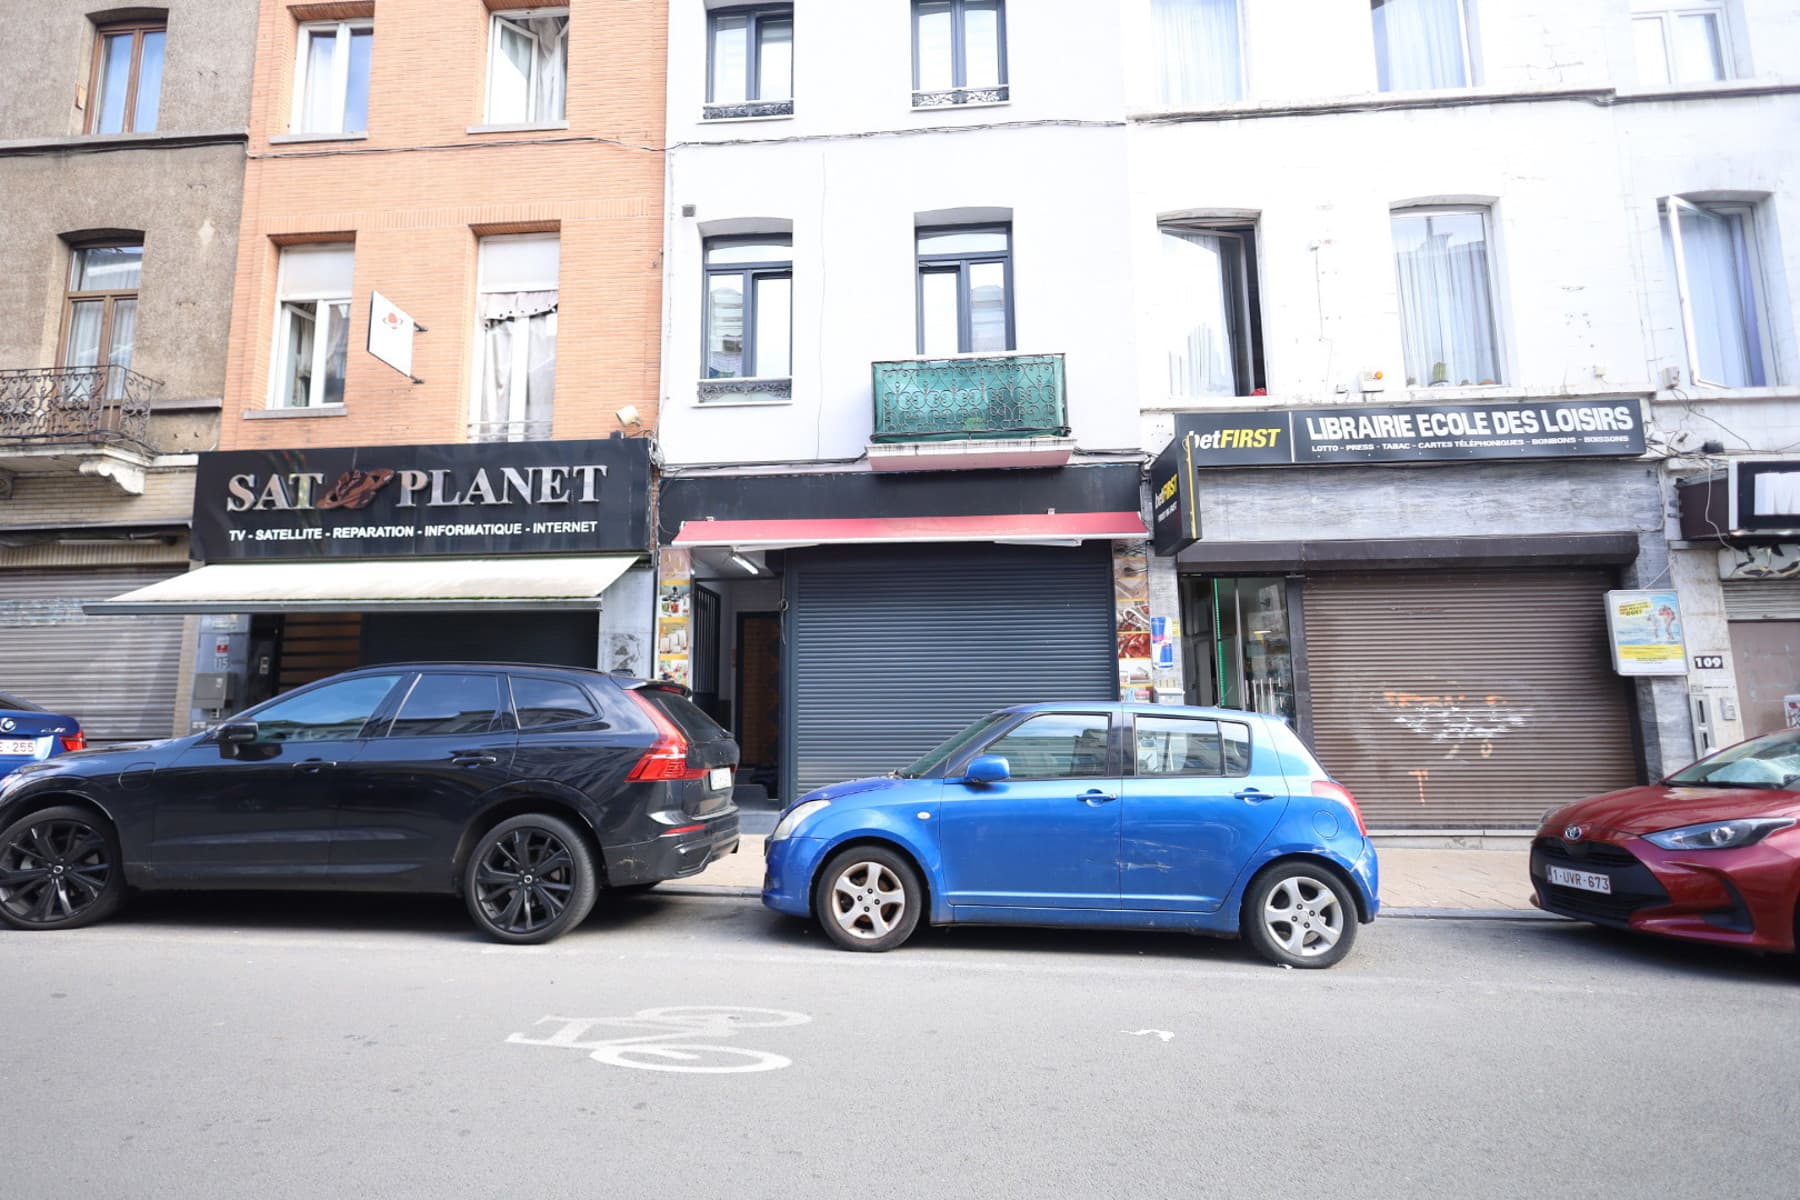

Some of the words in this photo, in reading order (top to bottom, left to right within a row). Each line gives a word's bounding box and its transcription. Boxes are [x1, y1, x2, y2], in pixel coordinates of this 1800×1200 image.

[1306, 415, 1416, 440] LIBRAIRIE
[1416, 412, 1491, 437] ECOLE
[1492, 410, 1540, 434] DES
[1541, 407, 1634, 432] LOISIRS
[1418, 441, 1453, 449] CARTES
[227, 472, 324, 512] SAT
[395, 465, 608, 508] PLANET
[229, 530, 246, 541] TV
[255, 528, 322, 541] SATELLITE
[333, 526, 414, 539] REPARATION
[425, 523, 522, 537] INFORMATIQUE
[533, 521, 598, 534] INTERNET
[1695, 657, 1721, 668] 109
